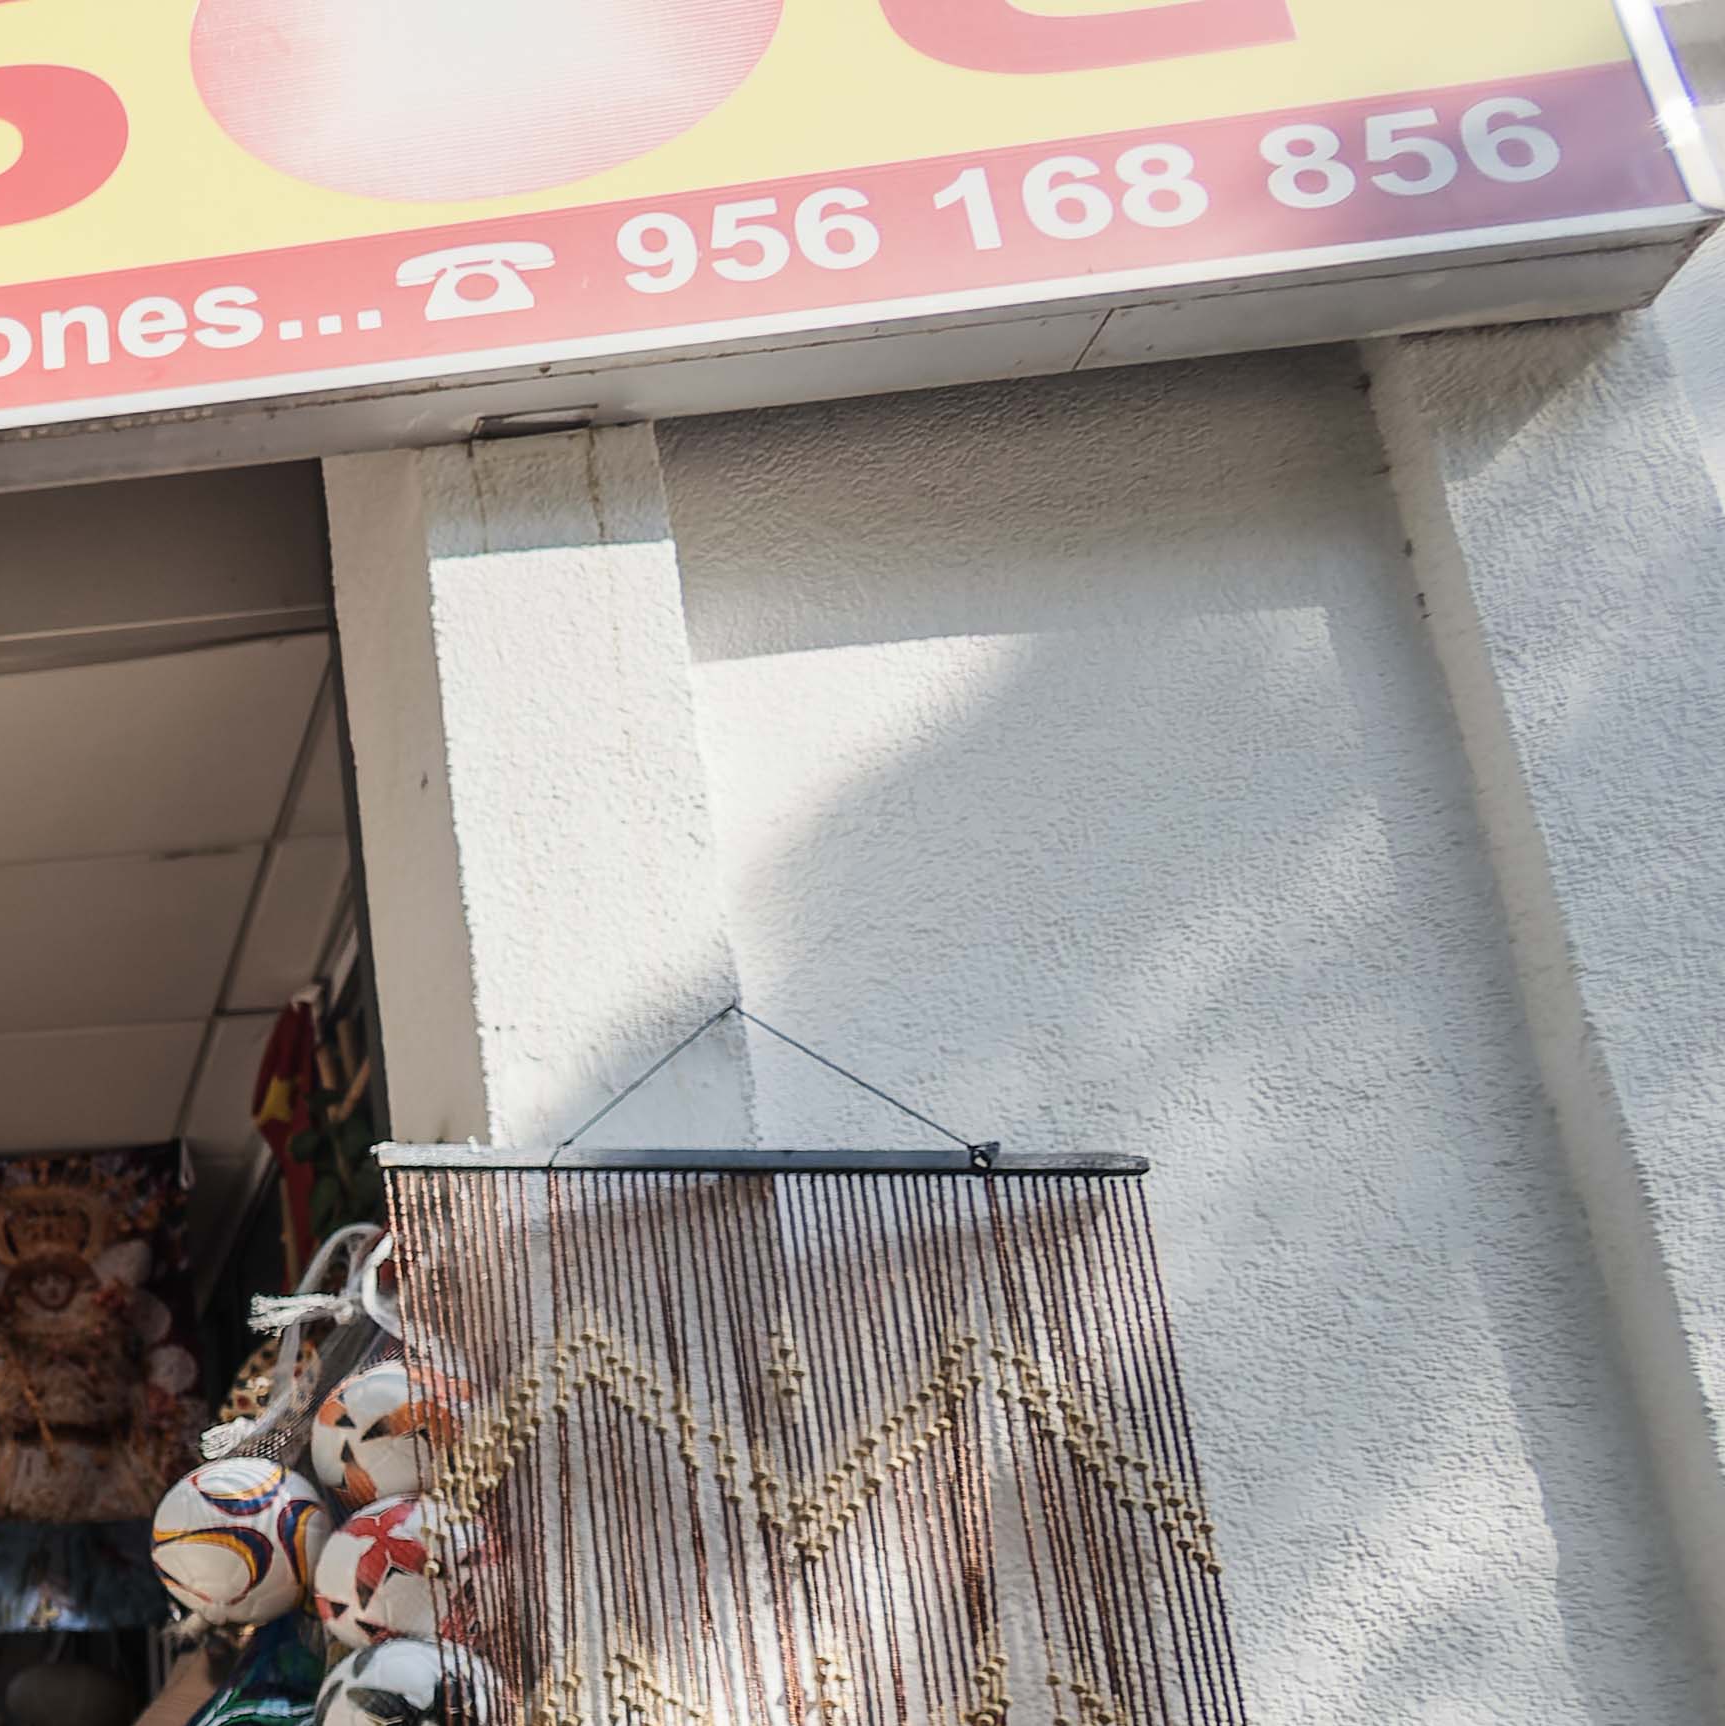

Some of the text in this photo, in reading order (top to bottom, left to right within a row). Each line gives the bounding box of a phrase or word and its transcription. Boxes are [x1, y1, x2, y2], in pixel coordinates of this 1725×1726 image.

[615, 186, 883, 294] 956
[932, 142, 1210, 251] 168
[1260, 95, 1563, 209] 856
